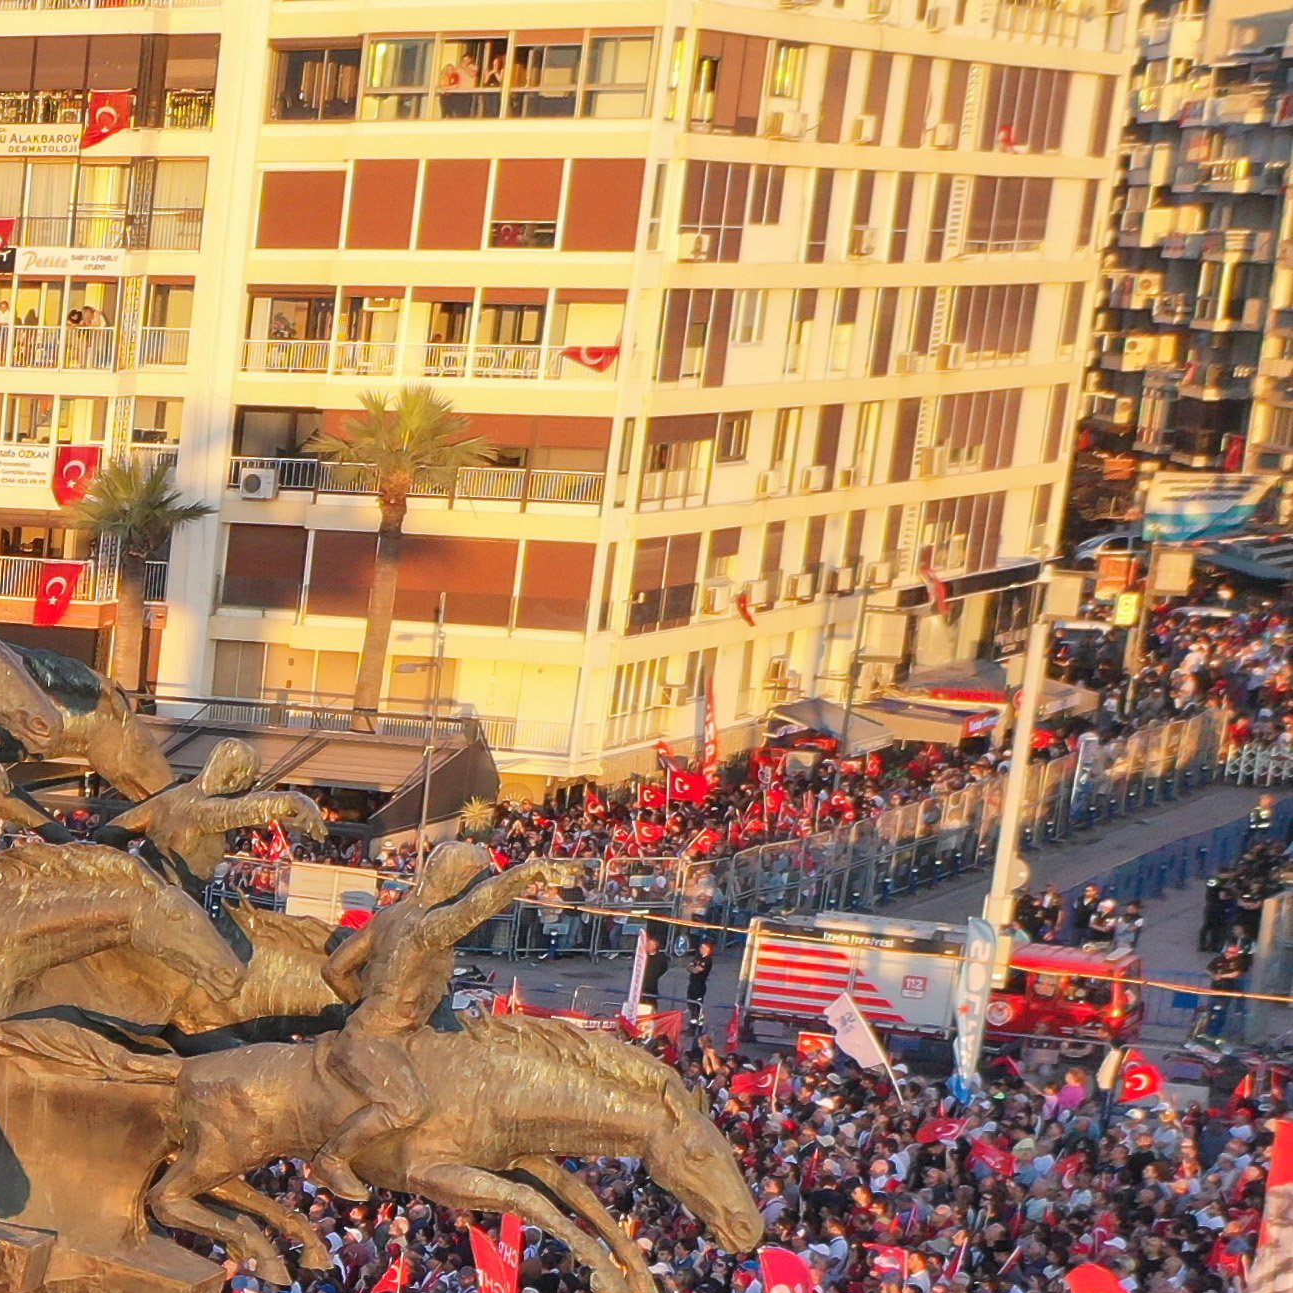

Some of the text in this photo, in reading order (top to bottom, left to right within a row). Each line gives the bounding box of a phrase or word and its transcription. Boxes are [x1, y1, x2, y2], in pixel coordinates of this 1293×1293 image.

[10, 133, 79, 144] ALAKBAROV
[22, 250, 70, 271] Petite
[18, 449, 49, 459] ÖZKAN
[904, 977, 925, 990] 112
